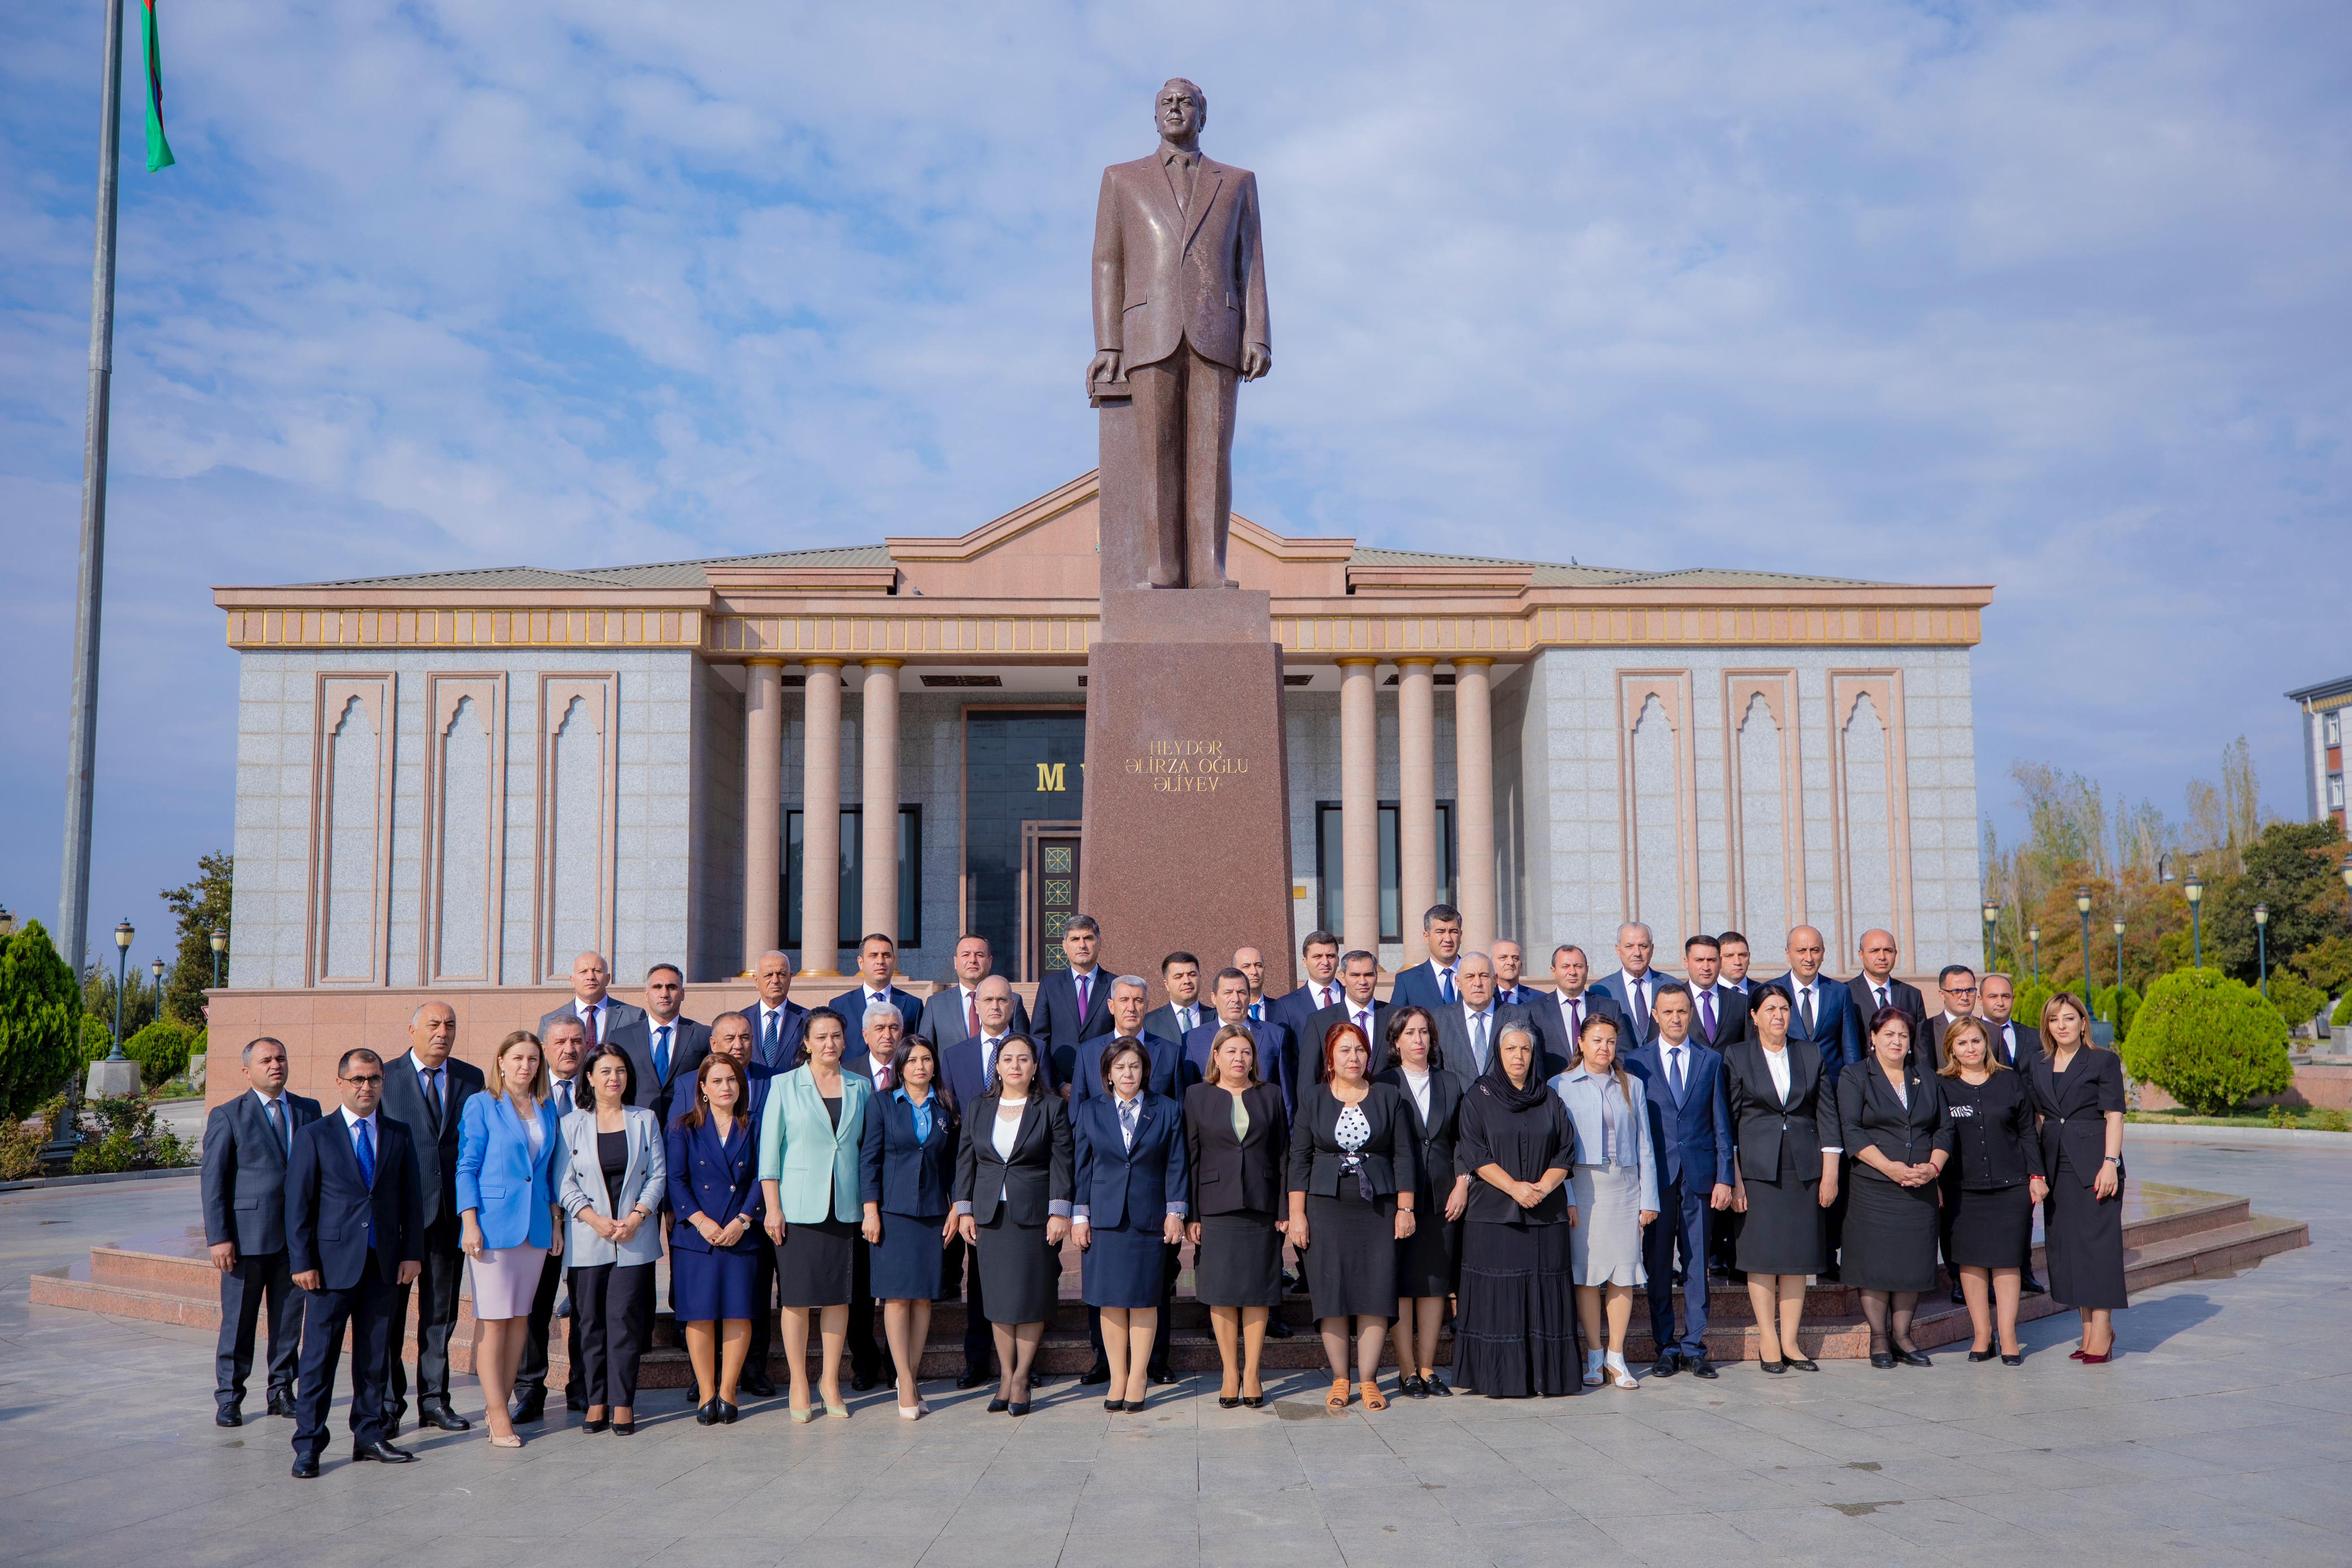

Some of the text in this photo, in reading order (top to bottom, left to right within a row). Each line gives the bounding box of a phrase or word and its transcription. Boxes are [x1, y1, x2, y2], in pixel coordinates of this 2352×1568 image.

[1150, 740, 1222, 755] HEYDƏR
[1126, 756, 1248, 774] ƏLİRZA OĞLU
[1036, 763, 1085, 791] M
[1154, 775, 1220, 792] ƏLİYEV
